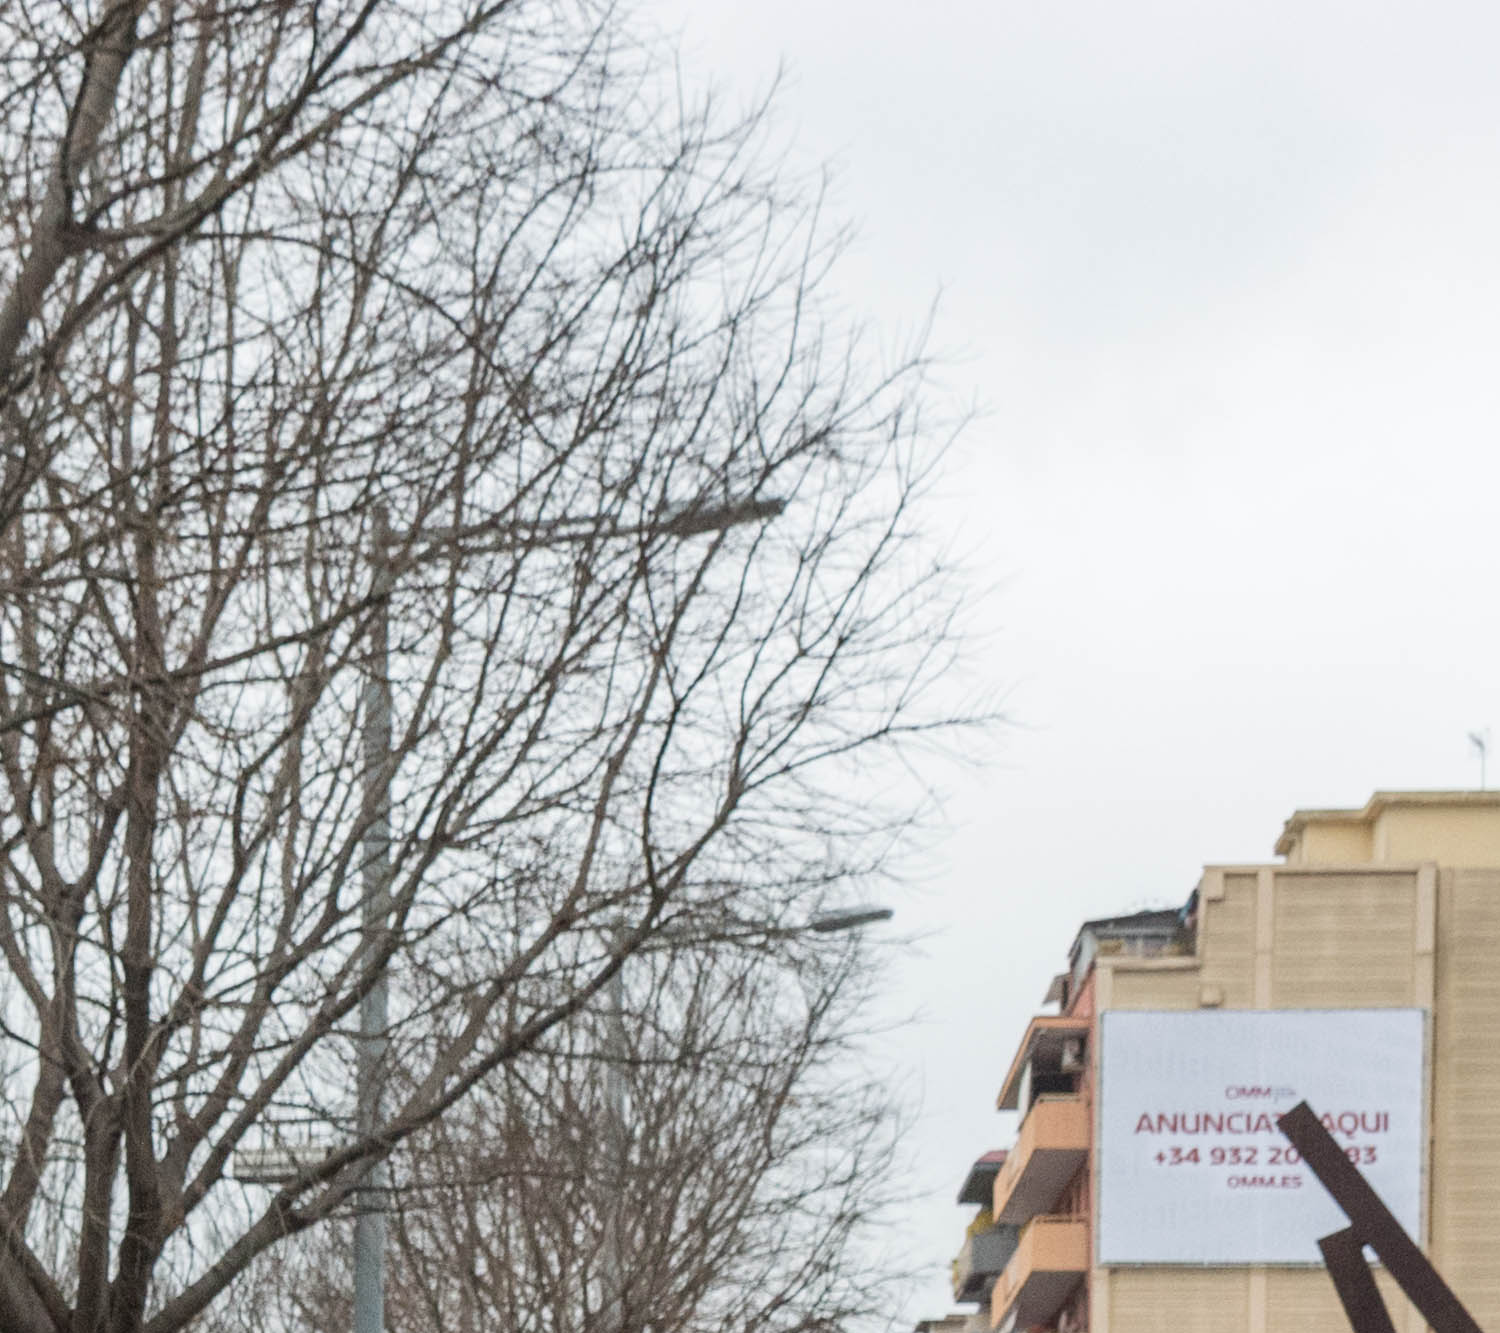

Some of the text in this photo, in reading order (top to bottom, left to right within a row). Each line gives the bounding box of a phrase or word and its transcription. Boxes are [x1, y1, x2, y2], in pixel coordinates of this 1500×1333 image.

[1134, 1111, 1284, 1135] ANUNCIA
[1155, 1147, 1201, 1165] +34
[1210, 1147, 1258, 1165] 932
[1267, 1146, 1301, 1166] 20
